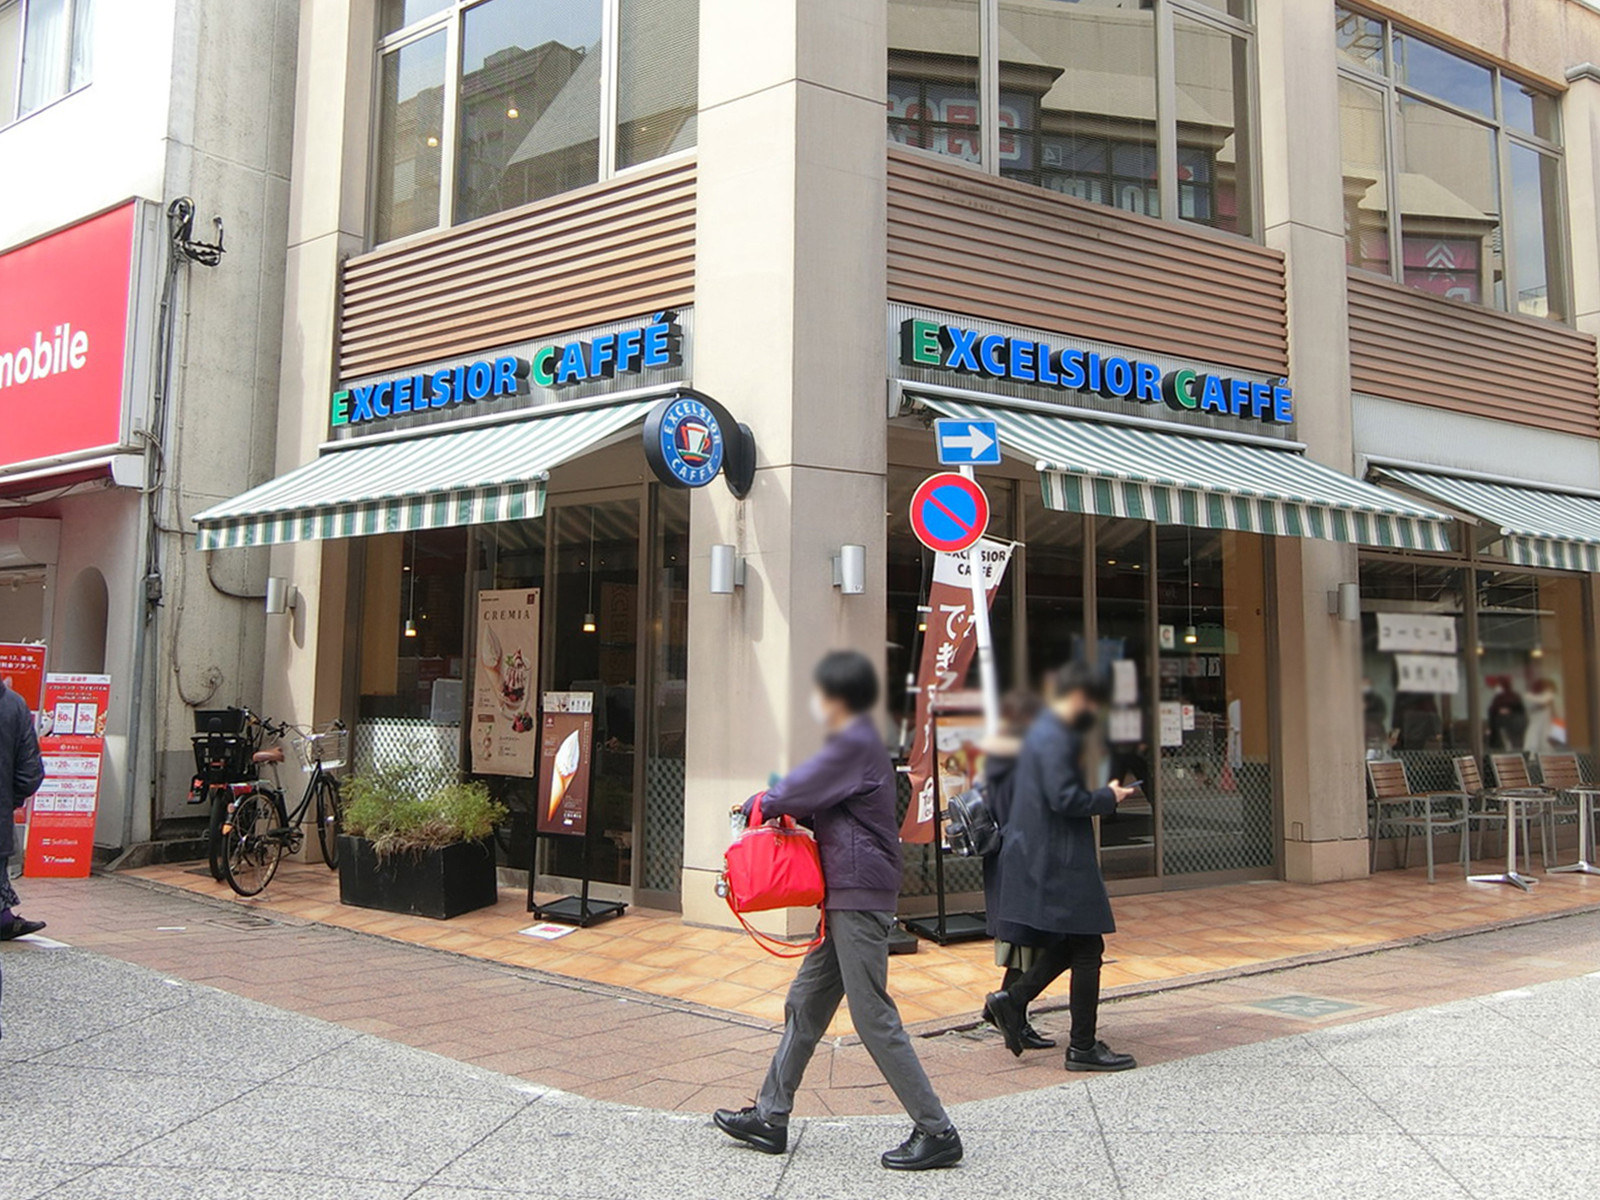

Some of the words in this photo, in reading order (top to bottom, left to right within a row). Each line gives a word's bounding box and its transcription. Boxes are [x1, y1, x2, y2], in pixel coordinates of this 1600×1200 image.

[331, 356, 519, 427] EXCELSIOR
[532, 311, 671, 387] CAFFÉ
[911, 318, 1162, 402] EXCELSIOR
[1173, 368, 1294, 424] CAFFÉ
[663, 402, 721, 445] EXCELSIOR
[957, 562, 993, 578] CAÉ
[483, 610, 531, 621] CREMIA
